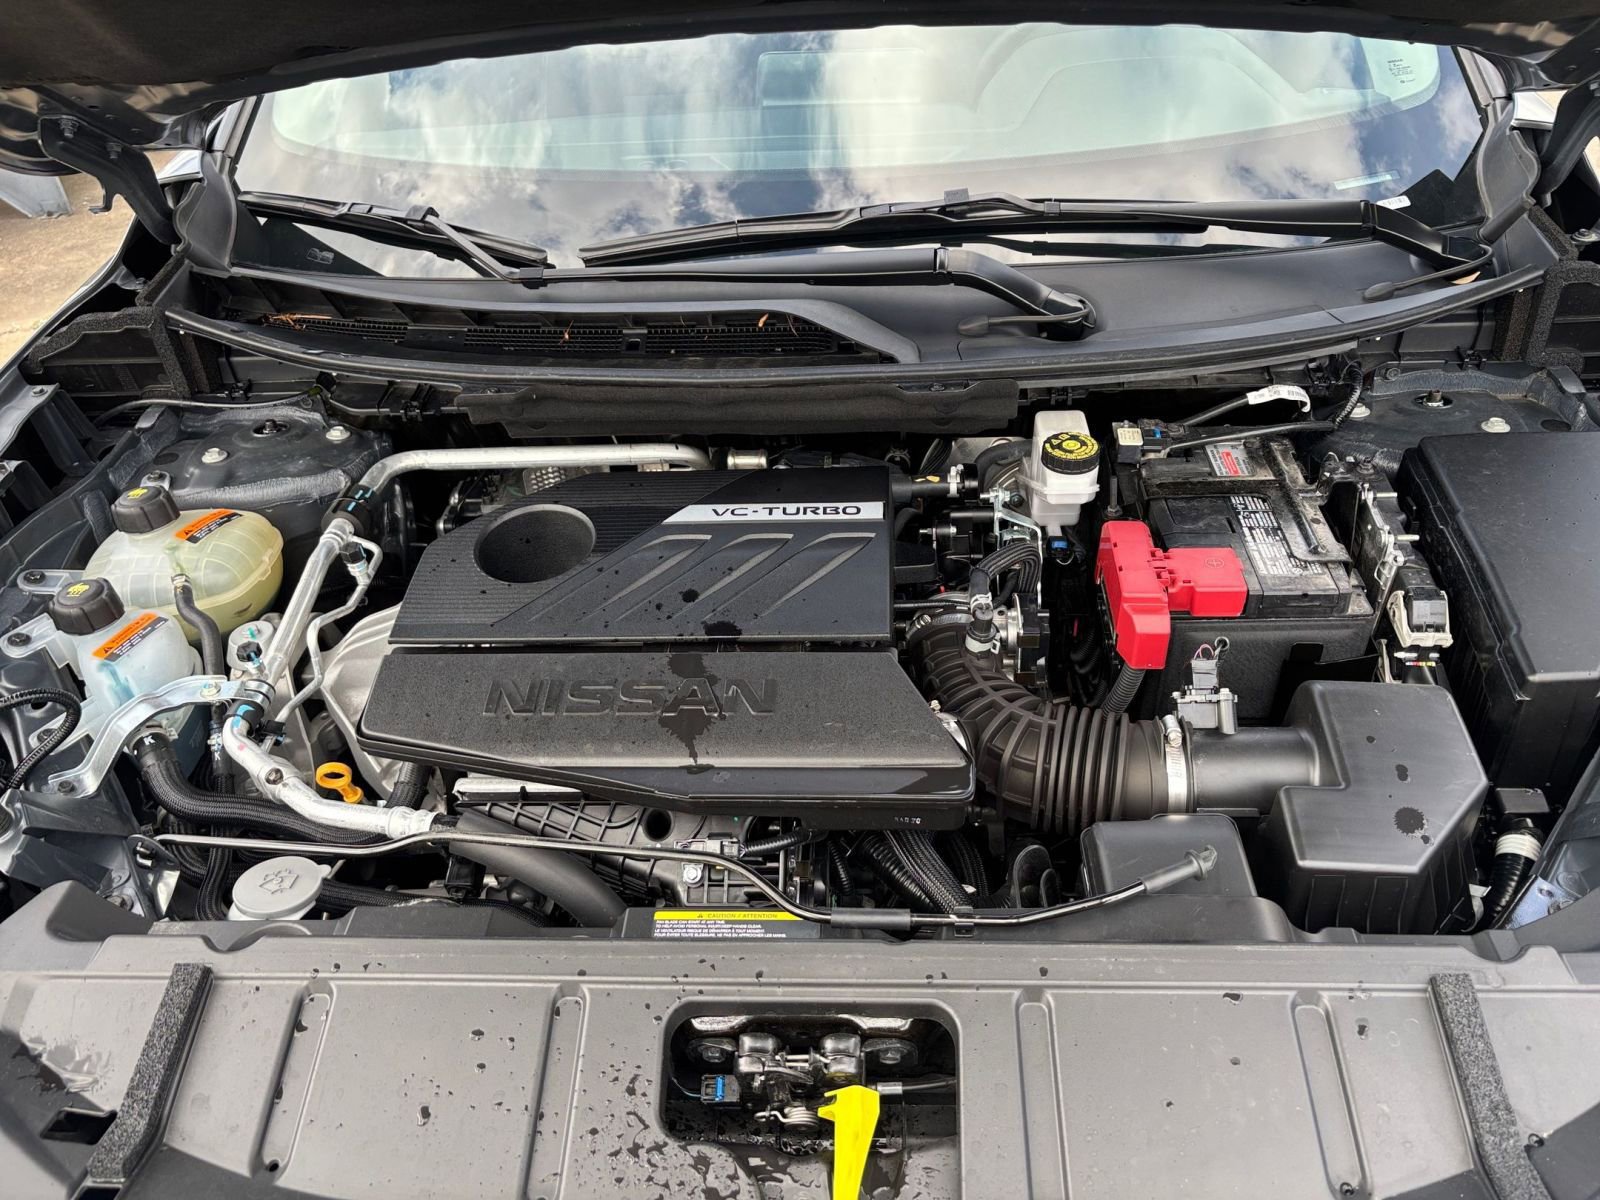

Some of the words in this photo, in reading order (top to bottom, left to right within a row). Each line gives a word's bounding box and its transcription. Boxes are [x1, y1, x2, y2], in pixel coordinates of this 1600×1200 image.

[712, 506, 861, 516] VC-TURBO
[482, 678, 776, 717] NISSAN
[143, 735, 156, 745] K
